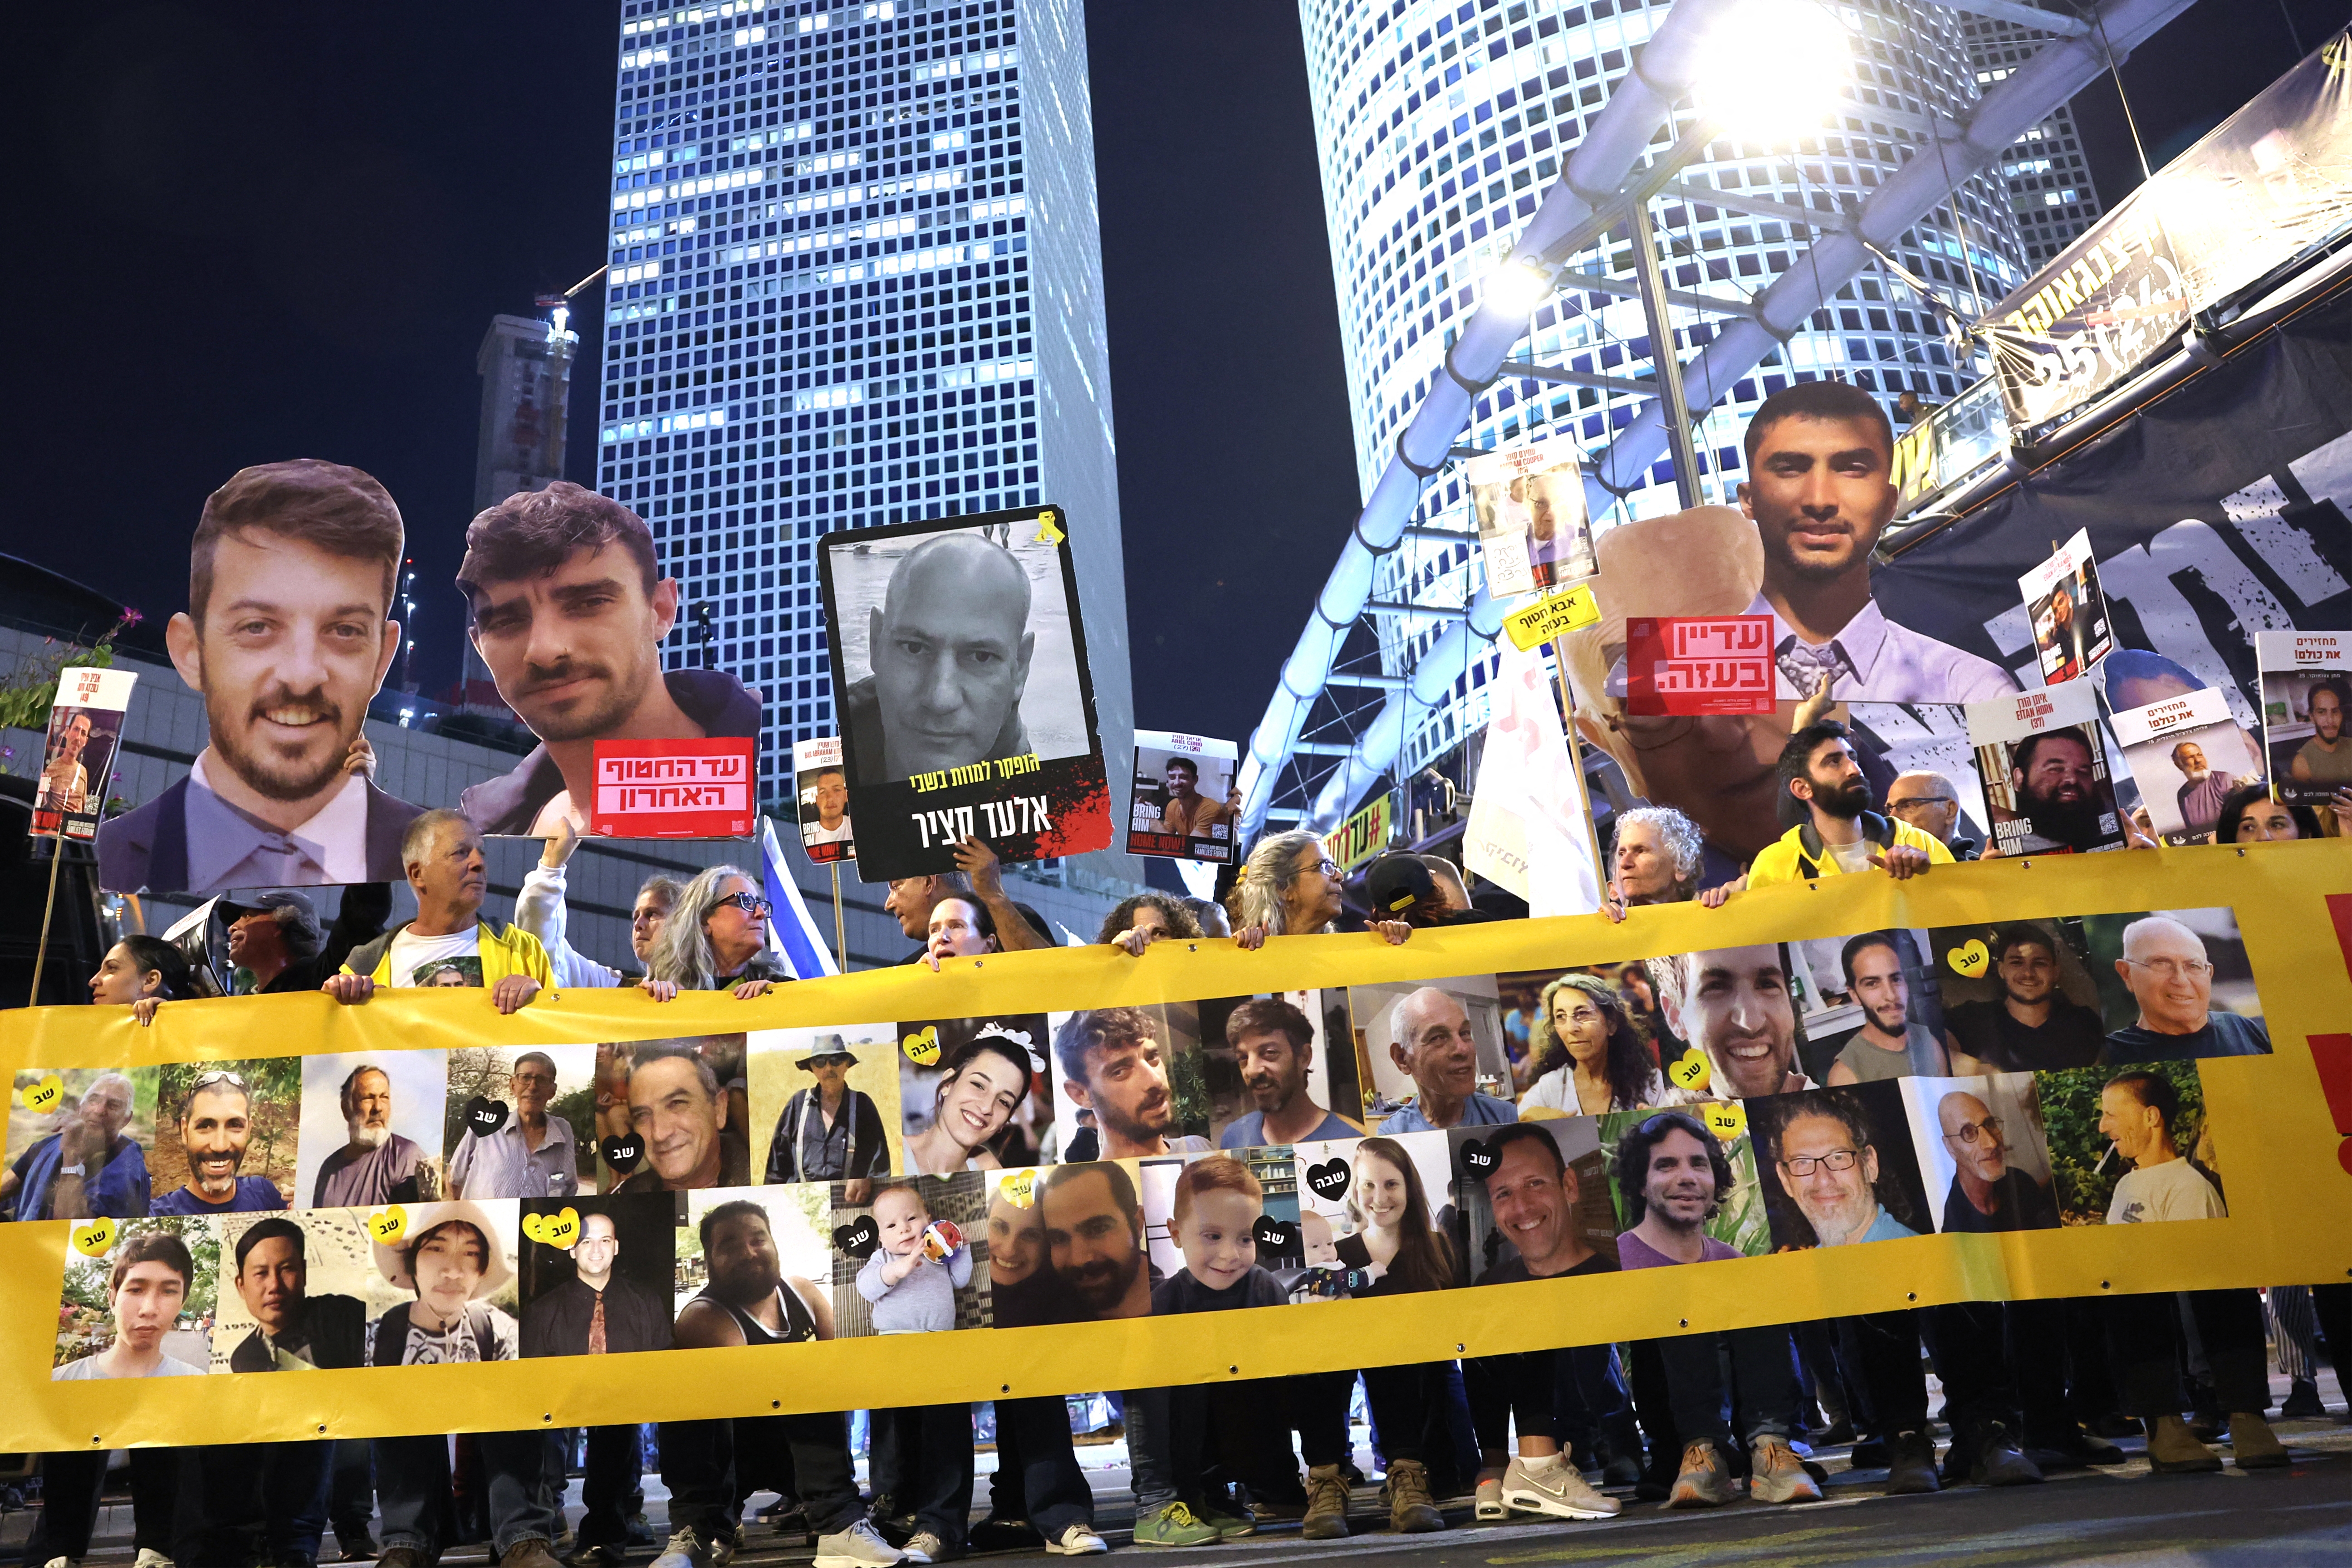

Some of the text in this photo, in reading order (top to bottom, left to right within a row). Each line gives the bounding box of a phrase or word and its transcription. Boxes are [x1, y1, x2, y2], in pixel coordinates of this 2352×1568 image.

[1519, 448, 1535, 458] עמירם
[1523, 454, 1544, 466] COOPER
[1519, 597, 1577, 628] אבא חטוף
[1541, 615, 1570, 635] בעזה
[1679, 625, 1763, 655] עדיין
[2297, 637, 2337, 646] מחזירים
[2041, 642, 2062, 665] BRING
[2294, 649, 2341, 659] את כולם!
[1657, 662, 1766, 689] בעזה.
[2017, 693, 2048, 710] איתן הורן
[2147, 701, 2187, 717] מחזירים
[2016, 703, 2054, 721] EITAN HORN
[2148, 710, 2195, 728] את כולם!
[2031, 716, 2045, 730] (37)
[813, 748, 833, 757] ABRAHAM
[821, 756, 833, 764] (23)
[606, 758, 739, 781] עד החטוף
[909, 753, 1041, 793] הופקר למוות בשבי
[619, 787, 725, 811] האחרון
[1133, 803, 1161, 819] BRING
[802, 820, 820, 835] BRING
[911, 794, 1053, 848] אלעד קציר
[1132, 818, 1150, 832] HIM
[1994, 817, 2033, 840] BRING
[804, 833, 815, 847] HIM
[1130, 833, 1186, 851] HOME NOW!
[1997, 837, 2024, 857] HIM
[1194, 848, 1228, 858] FAMILIES FORUM
[1960, 952, 1980, 968] שב
[911, 1038, 938, 1057] שבה
[1683, 1063, 1700, 1081] שב
[34, 1088, 54, 1105] שב
[475, 1110, 497, 1123] שב
[1715, 1117, 1735, 1127] שב
[613, 1147, 634, 1159] שב
[1470, 1153, 1491, 1166] שב
[1315, 1171, 1345, 1187] שבה
[380, 1219, 398, 1235] שב
[552, 1222, 572, 1237] שב
[85, 1230, 106, 1247] שב
[848, 1230, 869, 1248] שב
[1262, 1230, 1284, 1244] שב
